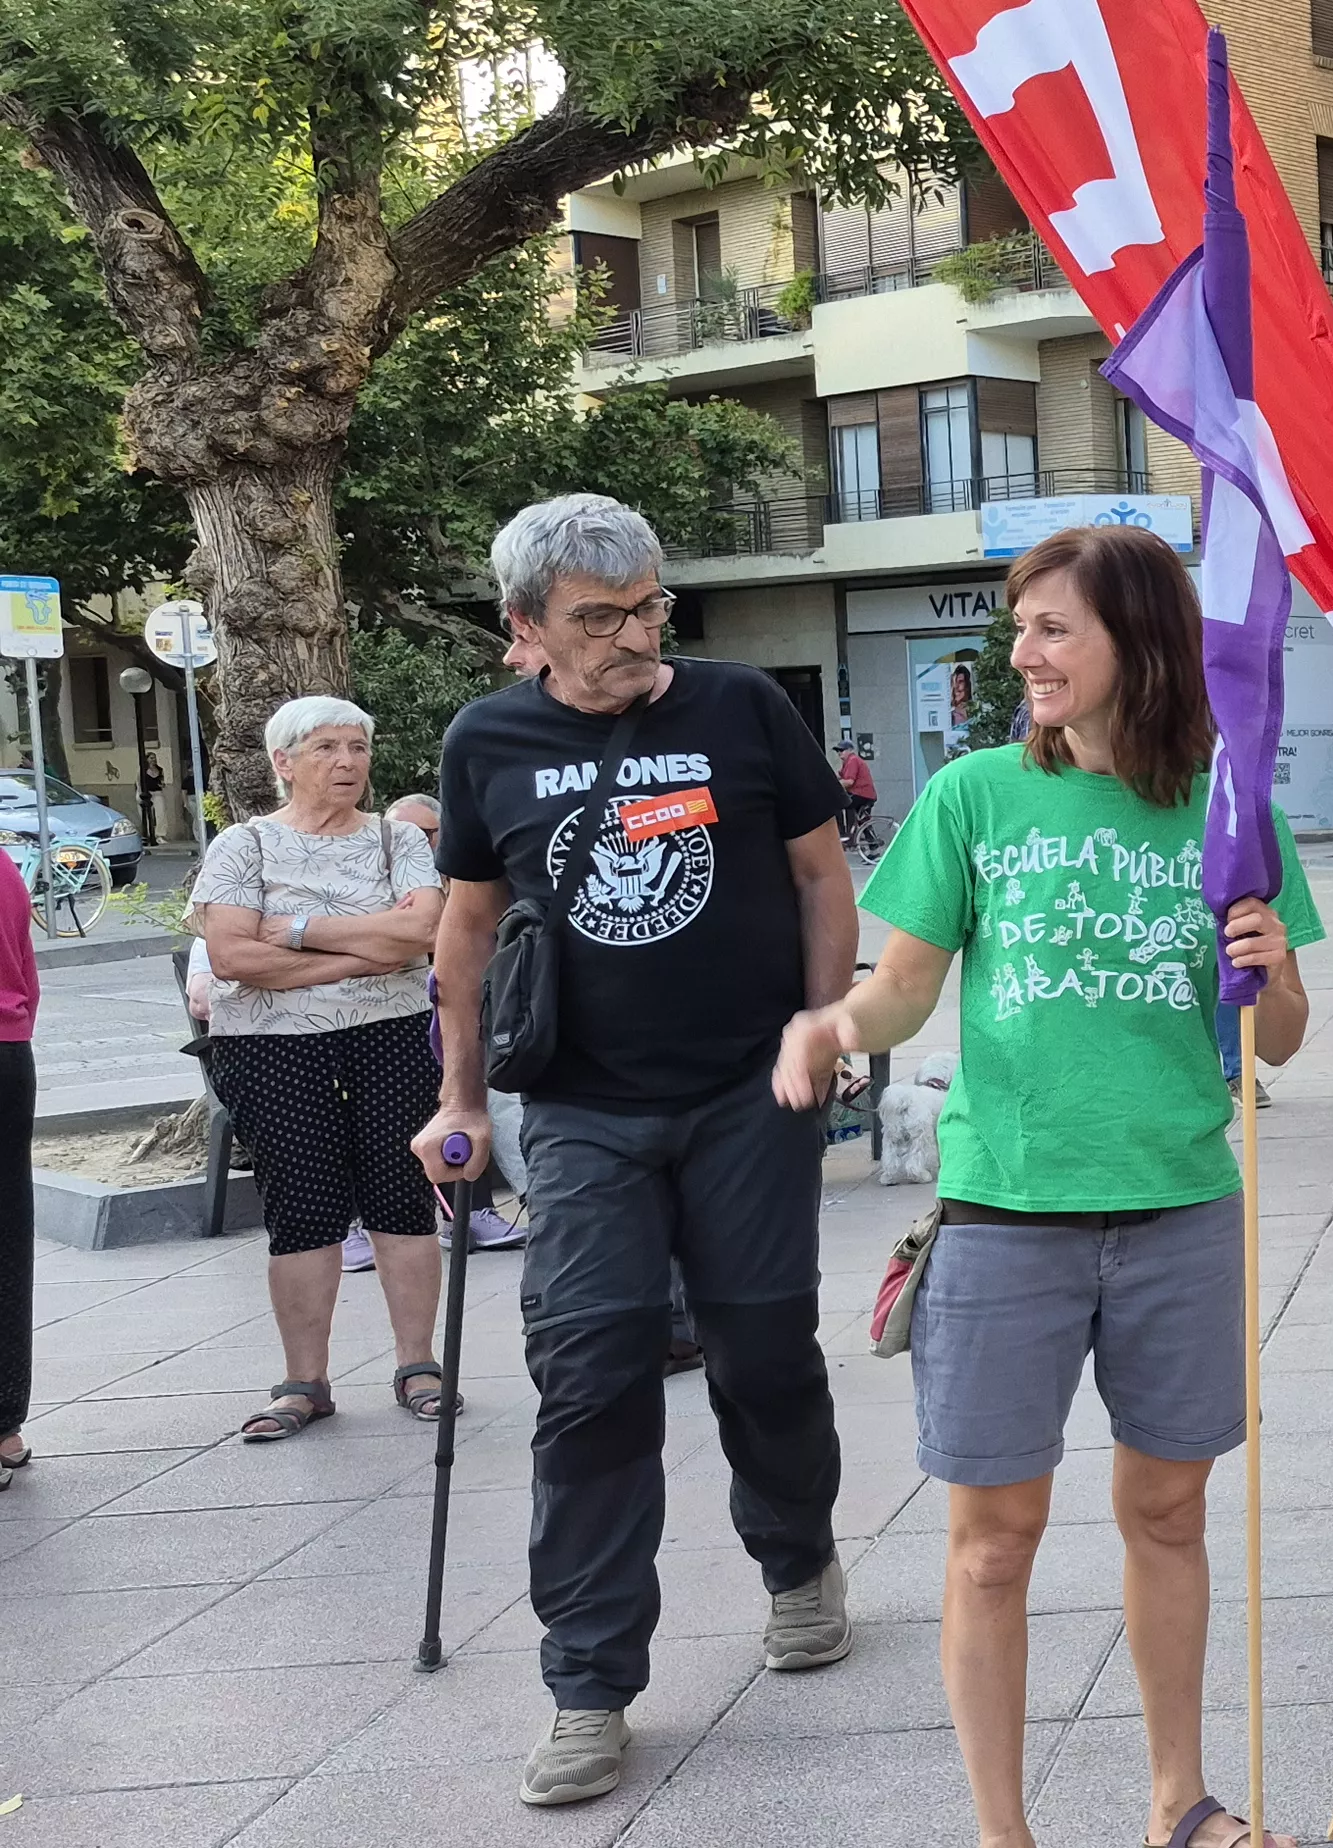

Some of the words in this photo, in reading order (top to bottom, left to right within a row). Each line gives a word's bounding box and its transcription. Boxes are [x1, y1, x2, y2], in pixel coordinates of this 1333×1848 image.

[626, 804, 686, 830] CCOO
[999, 913, 1047, 949] DE
[1067, 912, 1200, 950] TOD@S
